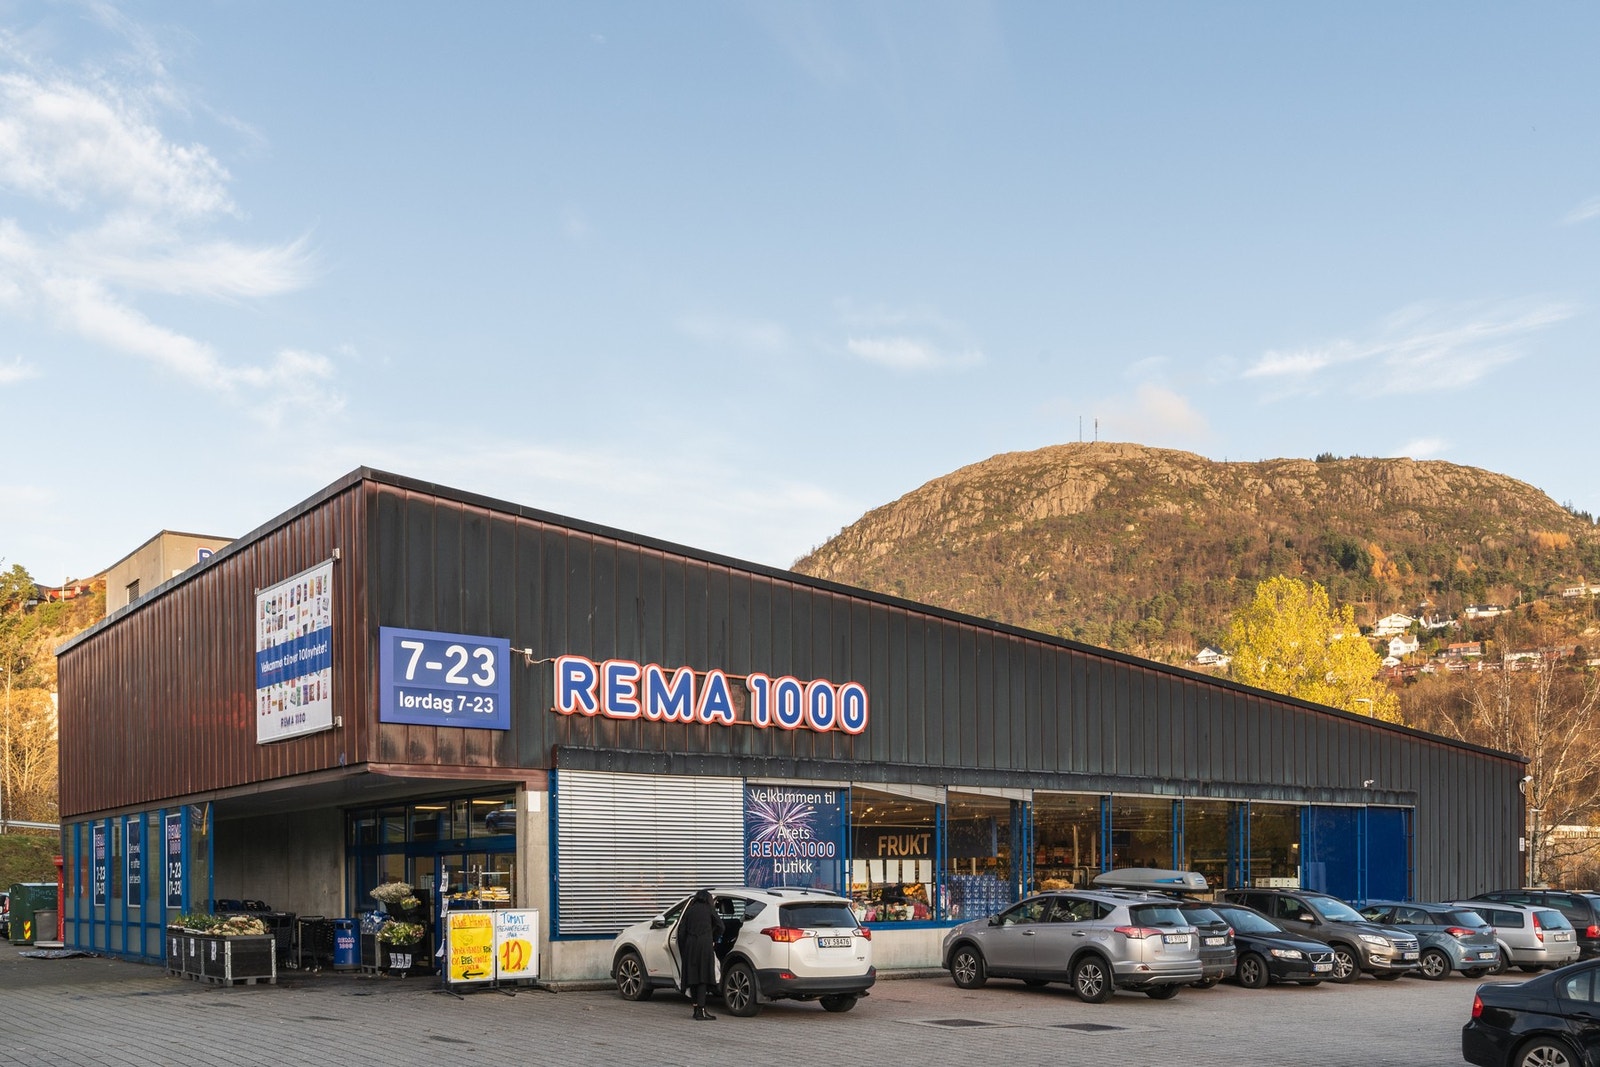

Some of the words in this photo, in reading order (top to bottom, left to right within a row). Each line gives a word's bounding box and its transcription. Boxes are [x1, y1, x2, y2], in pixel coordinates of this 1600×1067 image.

[400, 640, 496, 687] 7-23
[399, 691, 453, 714] lørdag
[457, 695, 494, 714] 7-23
[553, 654, 737, 726] REMA
[746, 672, 869, 735] 1000
[751, 788, 822, 804] Velkommen
[823, 790, 836, 804] til
[750, 840, 796, 858] REMA
[801, 841, 836, 858] 1000
[878, 833, 931, 856] FRUKT
[169, 862, 181, 878] 7-23
[773, 858, 813, 874] butikk
[500, 911, 526, 925] TOMAT
